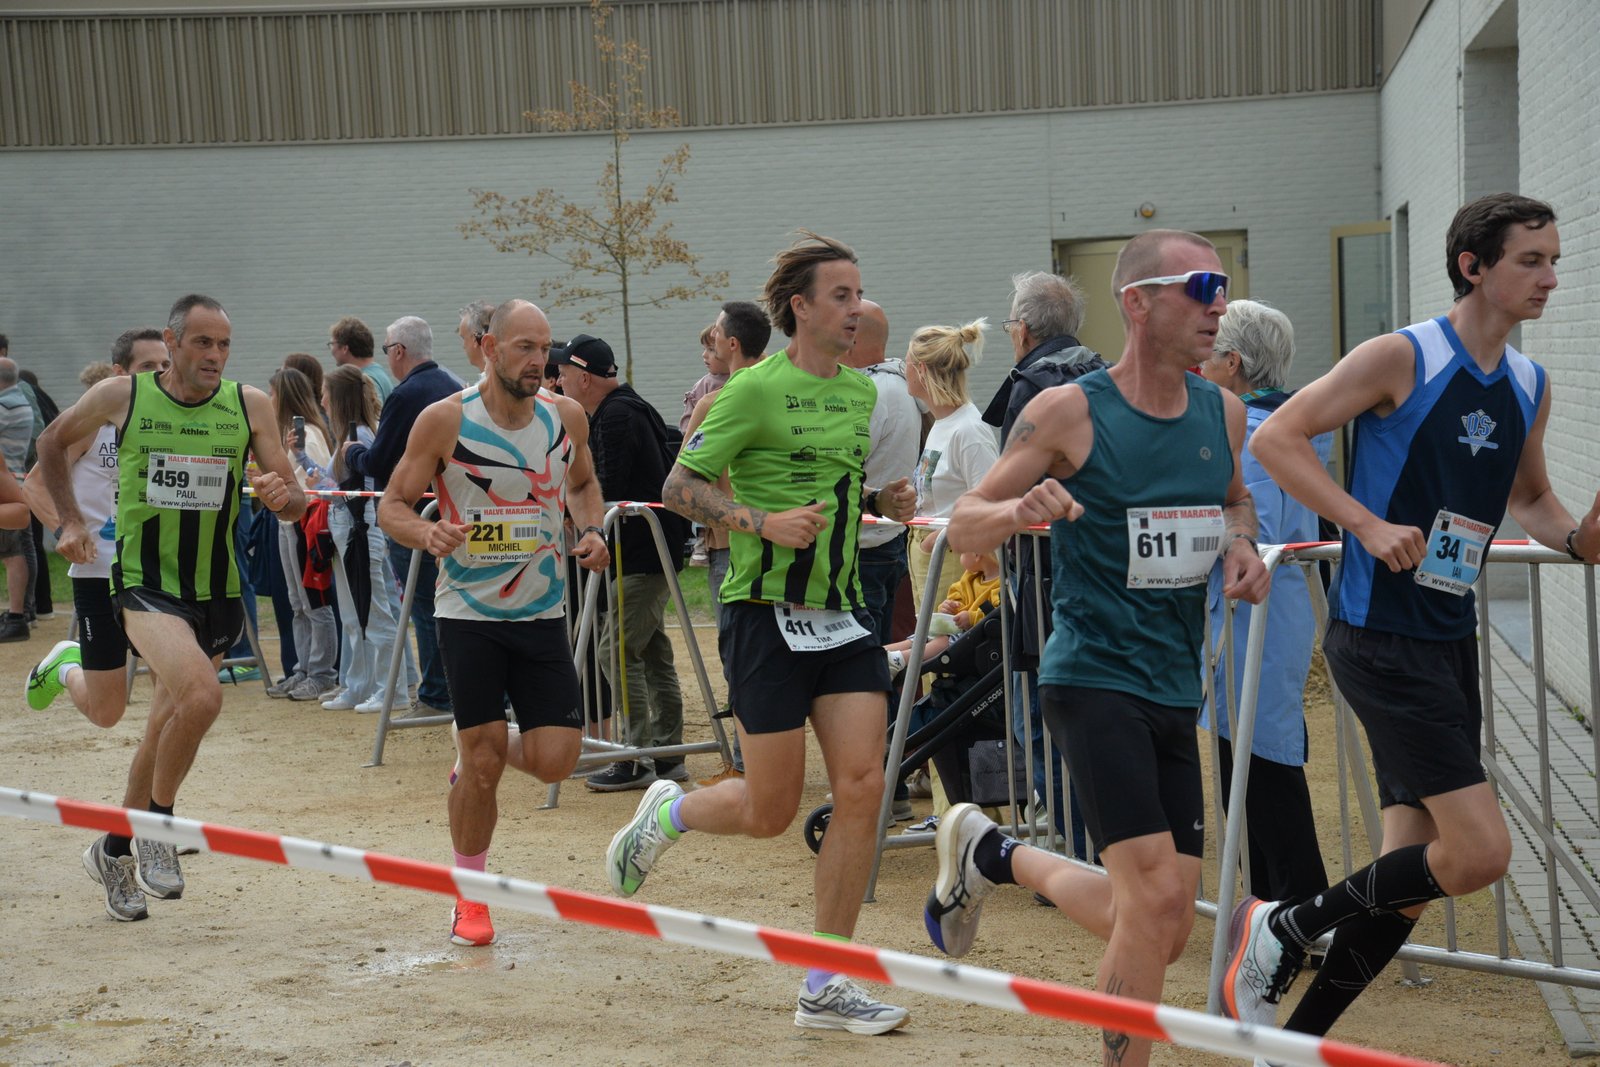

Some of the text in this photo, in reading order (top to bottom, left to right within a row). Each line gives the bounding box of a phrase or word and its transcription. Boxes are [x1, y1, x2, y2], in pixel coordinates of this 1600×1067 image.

[824, 404, 848, 413] Athlex
[180, 428, 209, 436] Athlex
[167, 455, 189, 463] HALVE
[190, 457, 227, 465] MARATHON
[151, 470, 190, 488] 459
[176, 489, 198, 499] PAUL
[160, 499, 221, 509] www.plusprint.be
[1151, 510, 1179, 520] HALVE
[470, 523, 504, 542] 221
[488, 542, 522, 552] MICHIEL
[1137, 531, 1177, 559] 611
[1436, 535, 1460, 563] 34
[785, 619, 816, 636] 411
[815, 635, 833, 643] TIM
